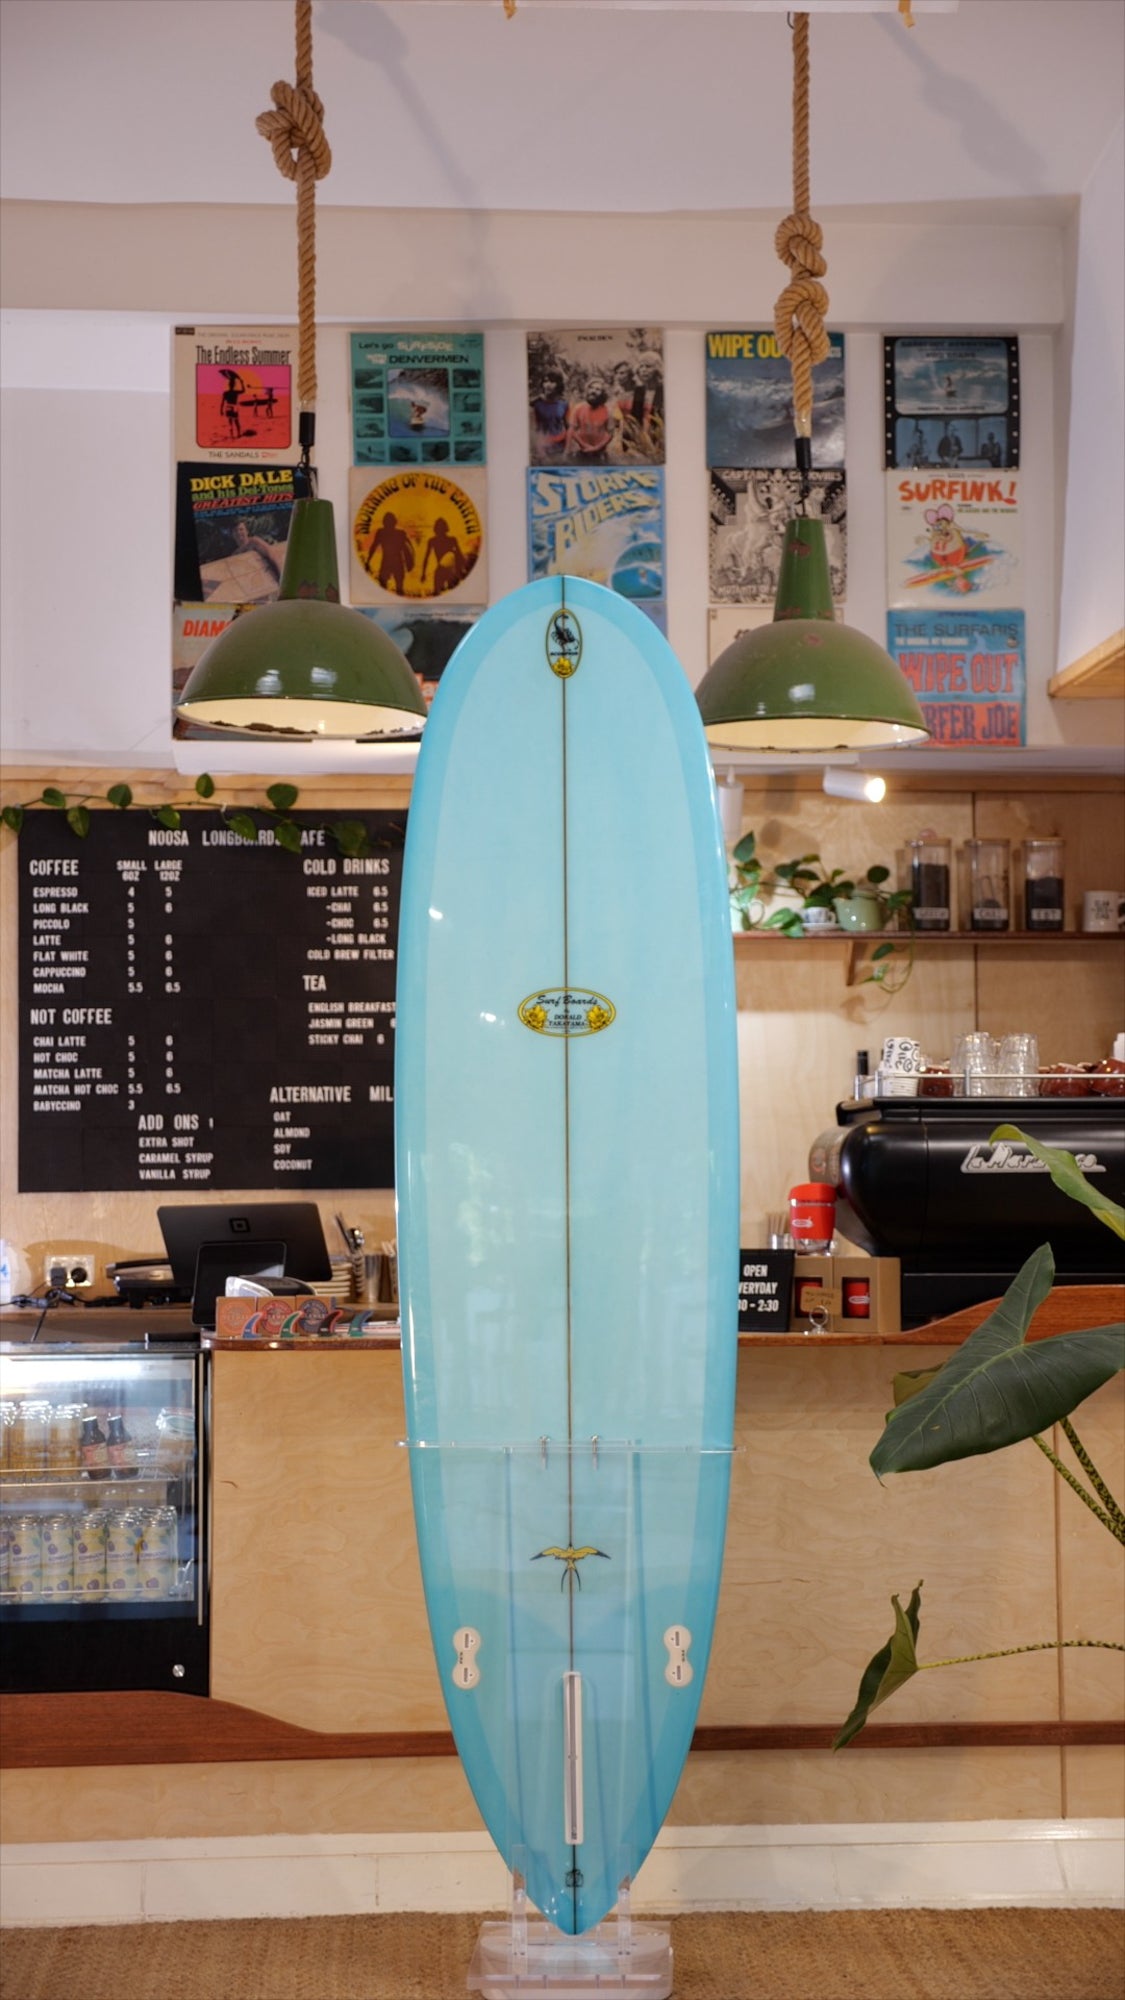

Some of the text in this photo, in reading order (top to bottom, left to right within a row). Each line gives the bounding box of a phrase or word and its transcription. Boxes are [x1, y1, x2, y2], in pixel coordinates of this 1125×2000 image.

[708, 333, 783, 358] WIPE OU
[196, 345, 292, 365] The Endless Summer
[388, 354, 470, 364] DENVERMEN
[224, 451, 260, 459] SANDALS
[191, 469, 294, 492] DICK DALE
[402, 474, 417, 488] OF
[423, 476, 447, 495] THE
[532, 469, 660, 516] STORM
[898, 479, 1018, 506] SURFINK!
[192, 496, 261, 512] GREATEST
[262, 492, 295, 504] HITS
[547, 491, 661, 575] RIDERS
[183, 619, 231, 637] DIAM
[895, 623, 1019, 638] THE SURFARIS
[899, 652, 1019, 694] WIPE OUT
[922, 704, 1018, 740] RFER JOE
[148, 829, 190, 847] NOOSA
[300, 829, 326, 847] AFE
[29, 859, 80, 876] COFFEE
[117, 860, 147, 871] SMALL
[155, 860, 183, 871] LARGE
[303, 858, 391, 876] COLD DRINKS
[33, 886, 174, 898] ESPRESSO 4 5
[306, 886, 329, 898] ICED
[331, 885, 360, 898] LATTE
[33, 902, 174, 914] LONG BLACK 5 6
[33, 918, 136, 930] PICCOLO 5
[33, 934, 174, 946] LATTE 5 6
[358, 933, 388, 945] BLACK
[33, 950, 174, 962] FLAT WHITE 5 6
[307, 948, 396, 961] COLD BREW FILTER
[33, 966, 174, 978] CAPPUCCINO 5 6
[33, 982, 66, 994] MOCHA
[128, 981, 145, 993] 5.5
[302, 974, 328, 992] TEA
[536, 994, 598, 1007] Surf Boards
[308, 1002, 346, 1014] ENGLISH
[30, 1007, 113, 1025] NOT COFFEE
[308, 1017, 344, 1029] JASMIN
[345, 1017, 375, 1029] GREEN
[33, 1035, 175, 1048] CHAI LATTE 5 6
[308, 1033, 386, 1045] STICKY CHAI 6
[33, 1050, 175, 1064] HOT CHOC 5 6
[33, 1067, 175, 1080] MATCHA LATTE 5 6
[33, 1084, 72, 1096] MATCHA
[74, 1083, 93, 1095] HOT
[95, 1083, 120, 1095] CHOC
[128, 1083, 145, 1095] 5.5
[269, 1085, 395, 1103] ALTERNATIVE MIL
[33, 1099, 136, 1112] BABYCCINO 3
[138, 1114, 165, 1131] ADD
[174, 1113, 200, 1131] ONS
[273, 1111, 292, 1123] OAT
[273, 1127, 311, 1139] ALMOND
[139, 1136, 196, 1148] EXTRA SHOT
[273, 1143, 292, 1155] SOY
[138, 1152, 215, 1164] CARAMEL SYRUP
[961, 1144, 984, 1169] La
[273, 1159, 313, 1171] COCONUT
[139, 1168, 212, 1180] VANILLA SYRUP
[743, 1264, 768, 1277] OPEN
[738, 1281, 778, 1295] VERYDAY
[757, 1299, 780, 1312] 2:30
